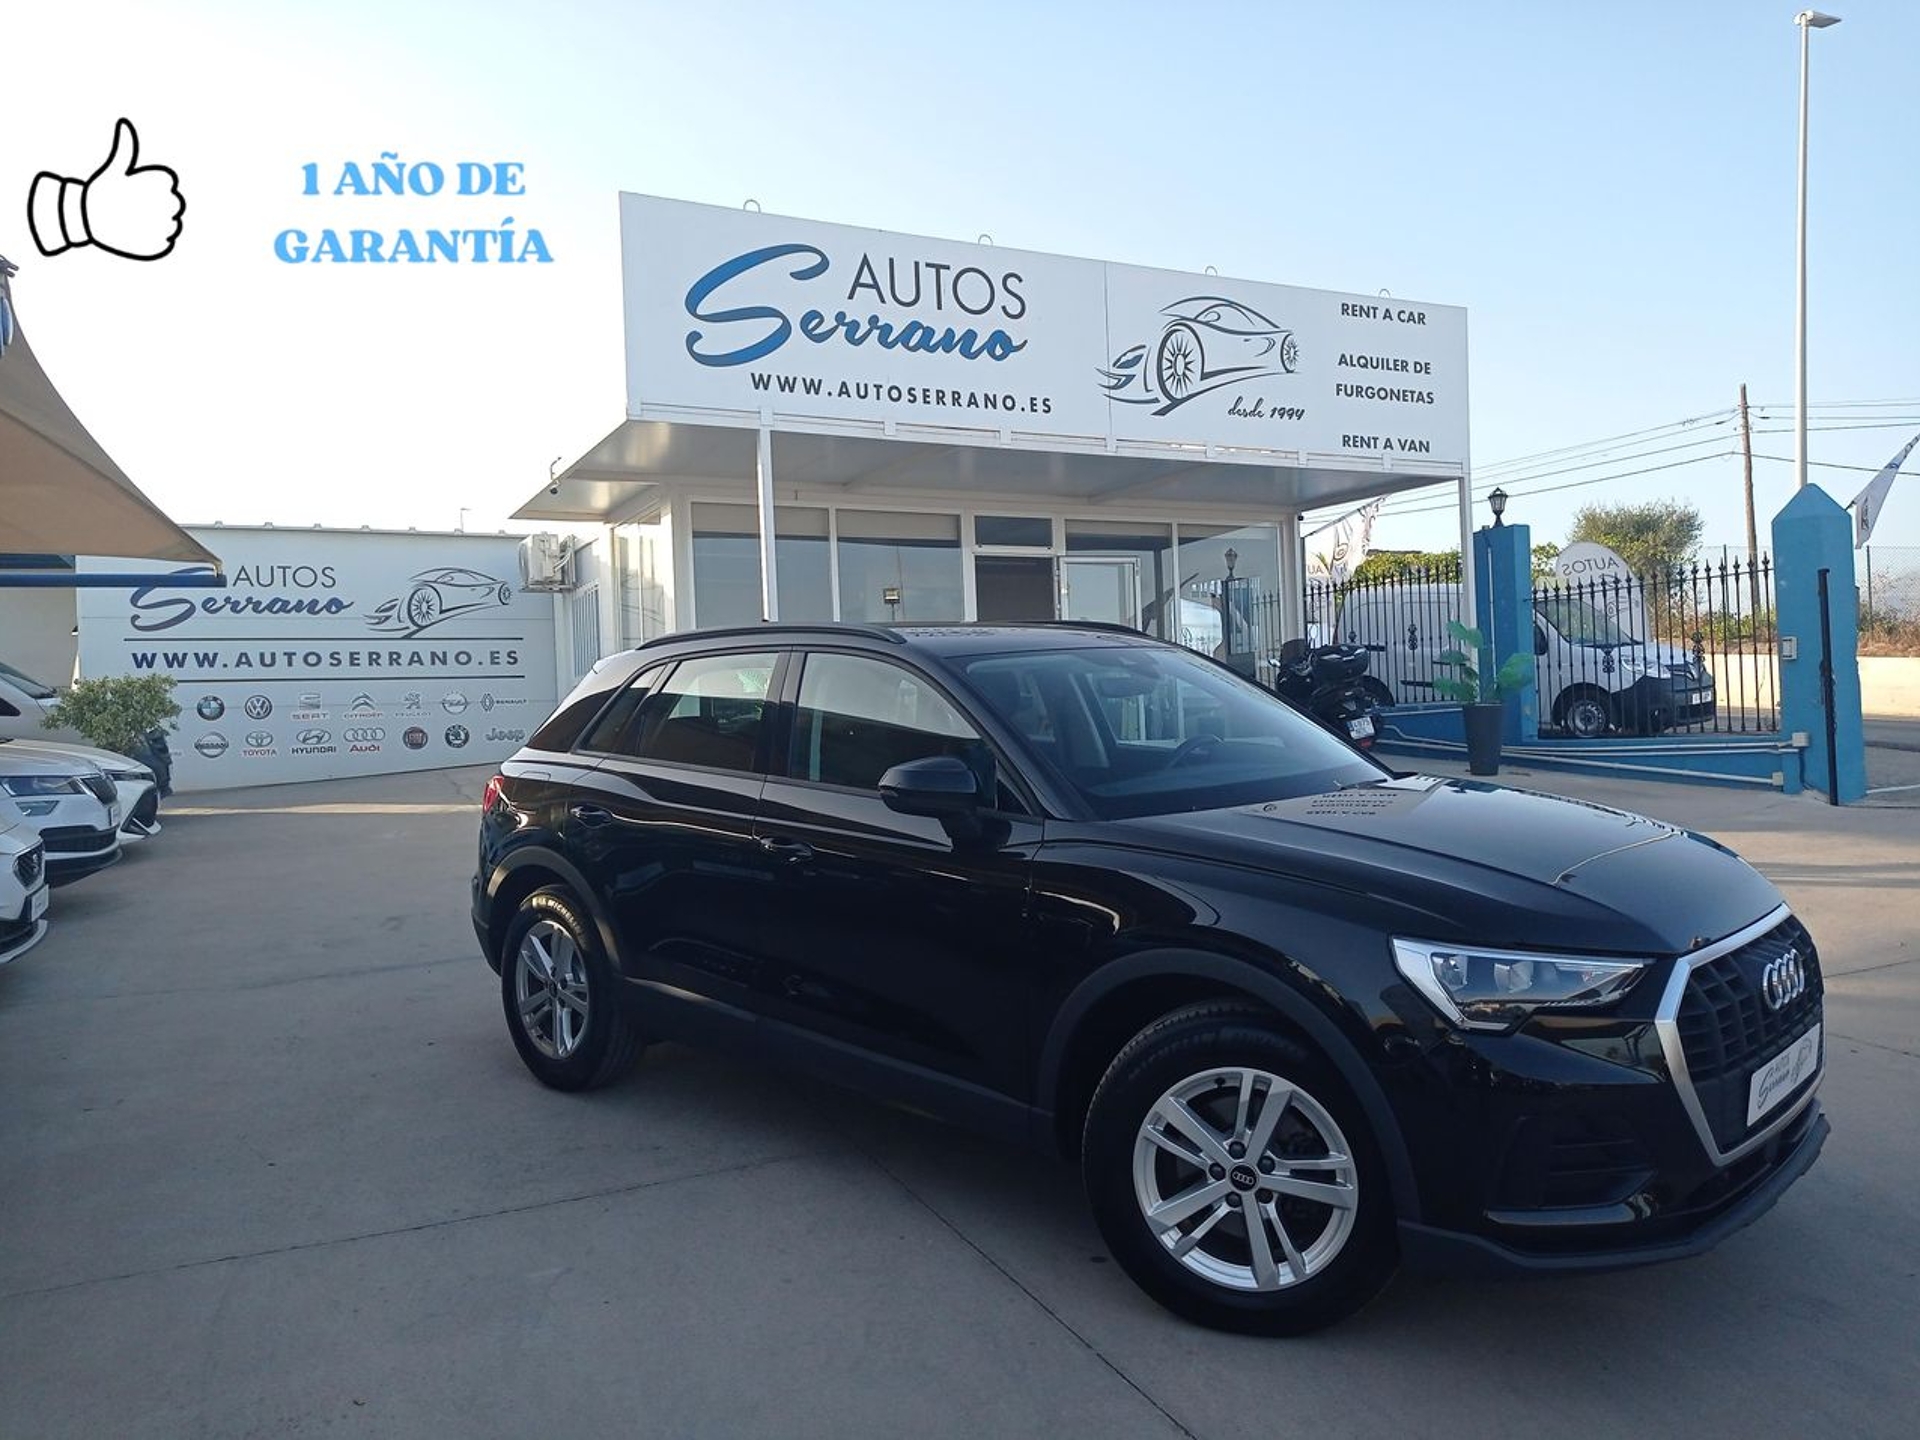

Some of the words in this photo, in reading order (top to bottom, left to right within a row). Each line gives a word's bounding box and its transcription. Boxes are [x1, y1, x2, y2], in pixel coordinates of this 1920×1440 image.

[846, 253, 1027, 320] AUTOS
[684, 243, 1029, 367] Serrano
[1341, 302, 1379, 319] RENT
[1382, 308, 1394, 321] A
[1397, 309, 1427, 326] CAR
[1337, 353, 1410, 373] ALQUILER
[1413, 360, 1432, 375] DE
[750, 372, 1053, 414] WWW.AUTOSERRANO.ES
[1335, 383, 1435, 405] FURGONETAS
[1227, 395, 1265, 418] desde
[1269, 406, 1306, 421] 1994
[1341, 434, 1380, 450] RENT
[1382, 437, 1394, 451] A
[1397, 437, 1431, 453] VAN
[232, 565, 337, 588] AUTOS
[130, 566, 355, 632] Serrano
[131, 649, 519, 669] WWW.AUTOSERRANO.ES
[485, 727, 526, 742] Jeep
[242, 749, 278, 757] TOYOTA
[291, 746, 337, 755] HYUNDAI
